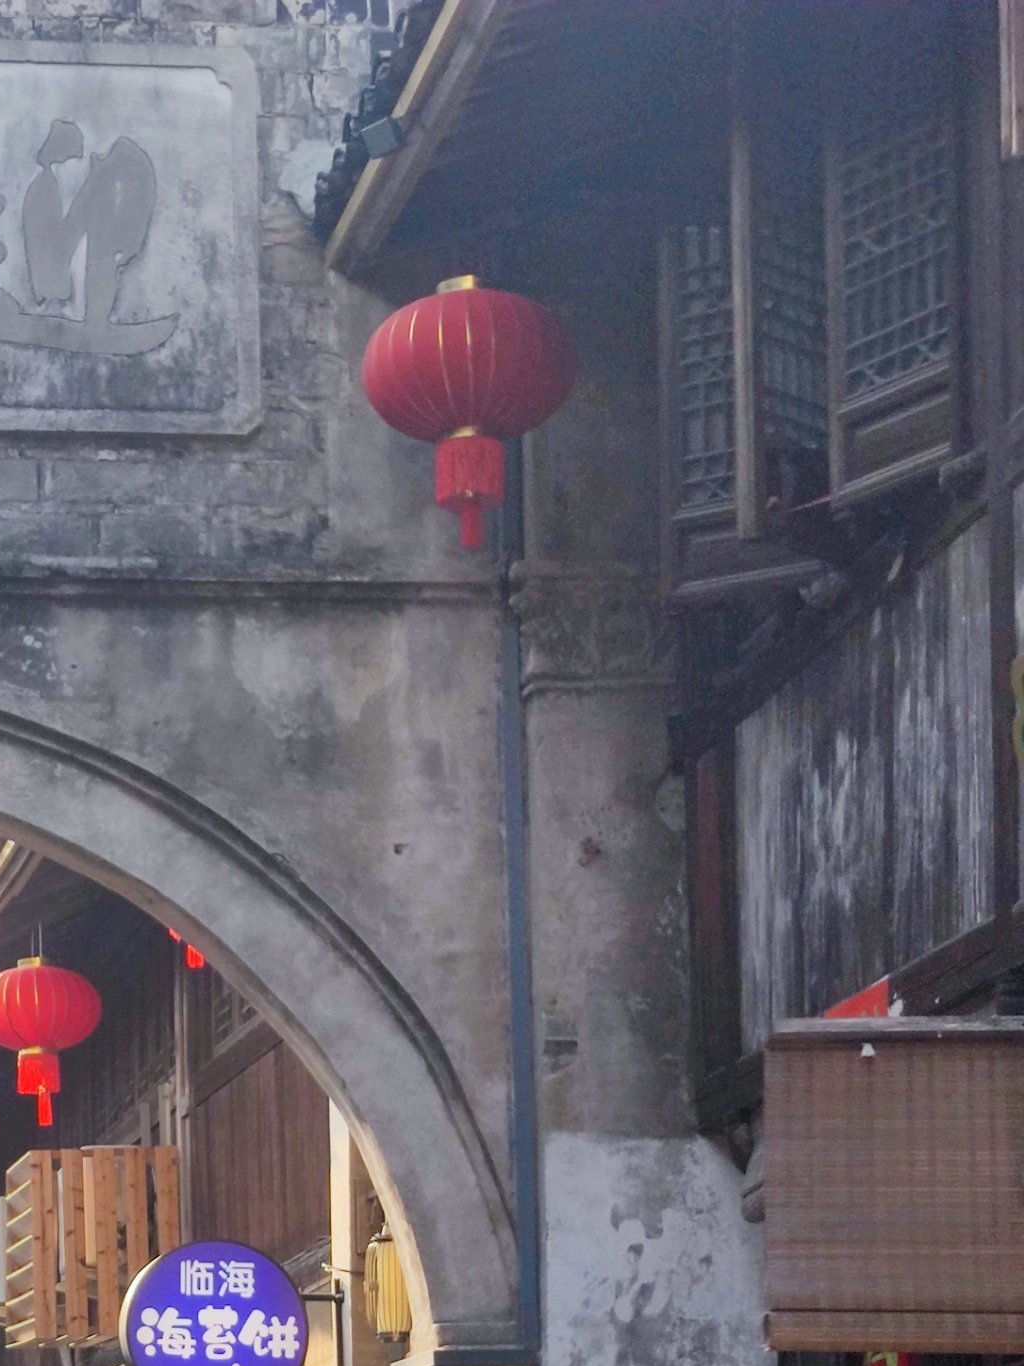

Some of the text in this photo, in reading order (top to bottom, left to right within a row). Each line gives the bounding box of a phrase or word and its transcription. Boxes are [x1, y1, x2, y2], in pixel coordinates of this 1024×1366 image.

[180, 1260, 255, 1298] 临海
[136, 1305, 300, 1360] 海苔饼
